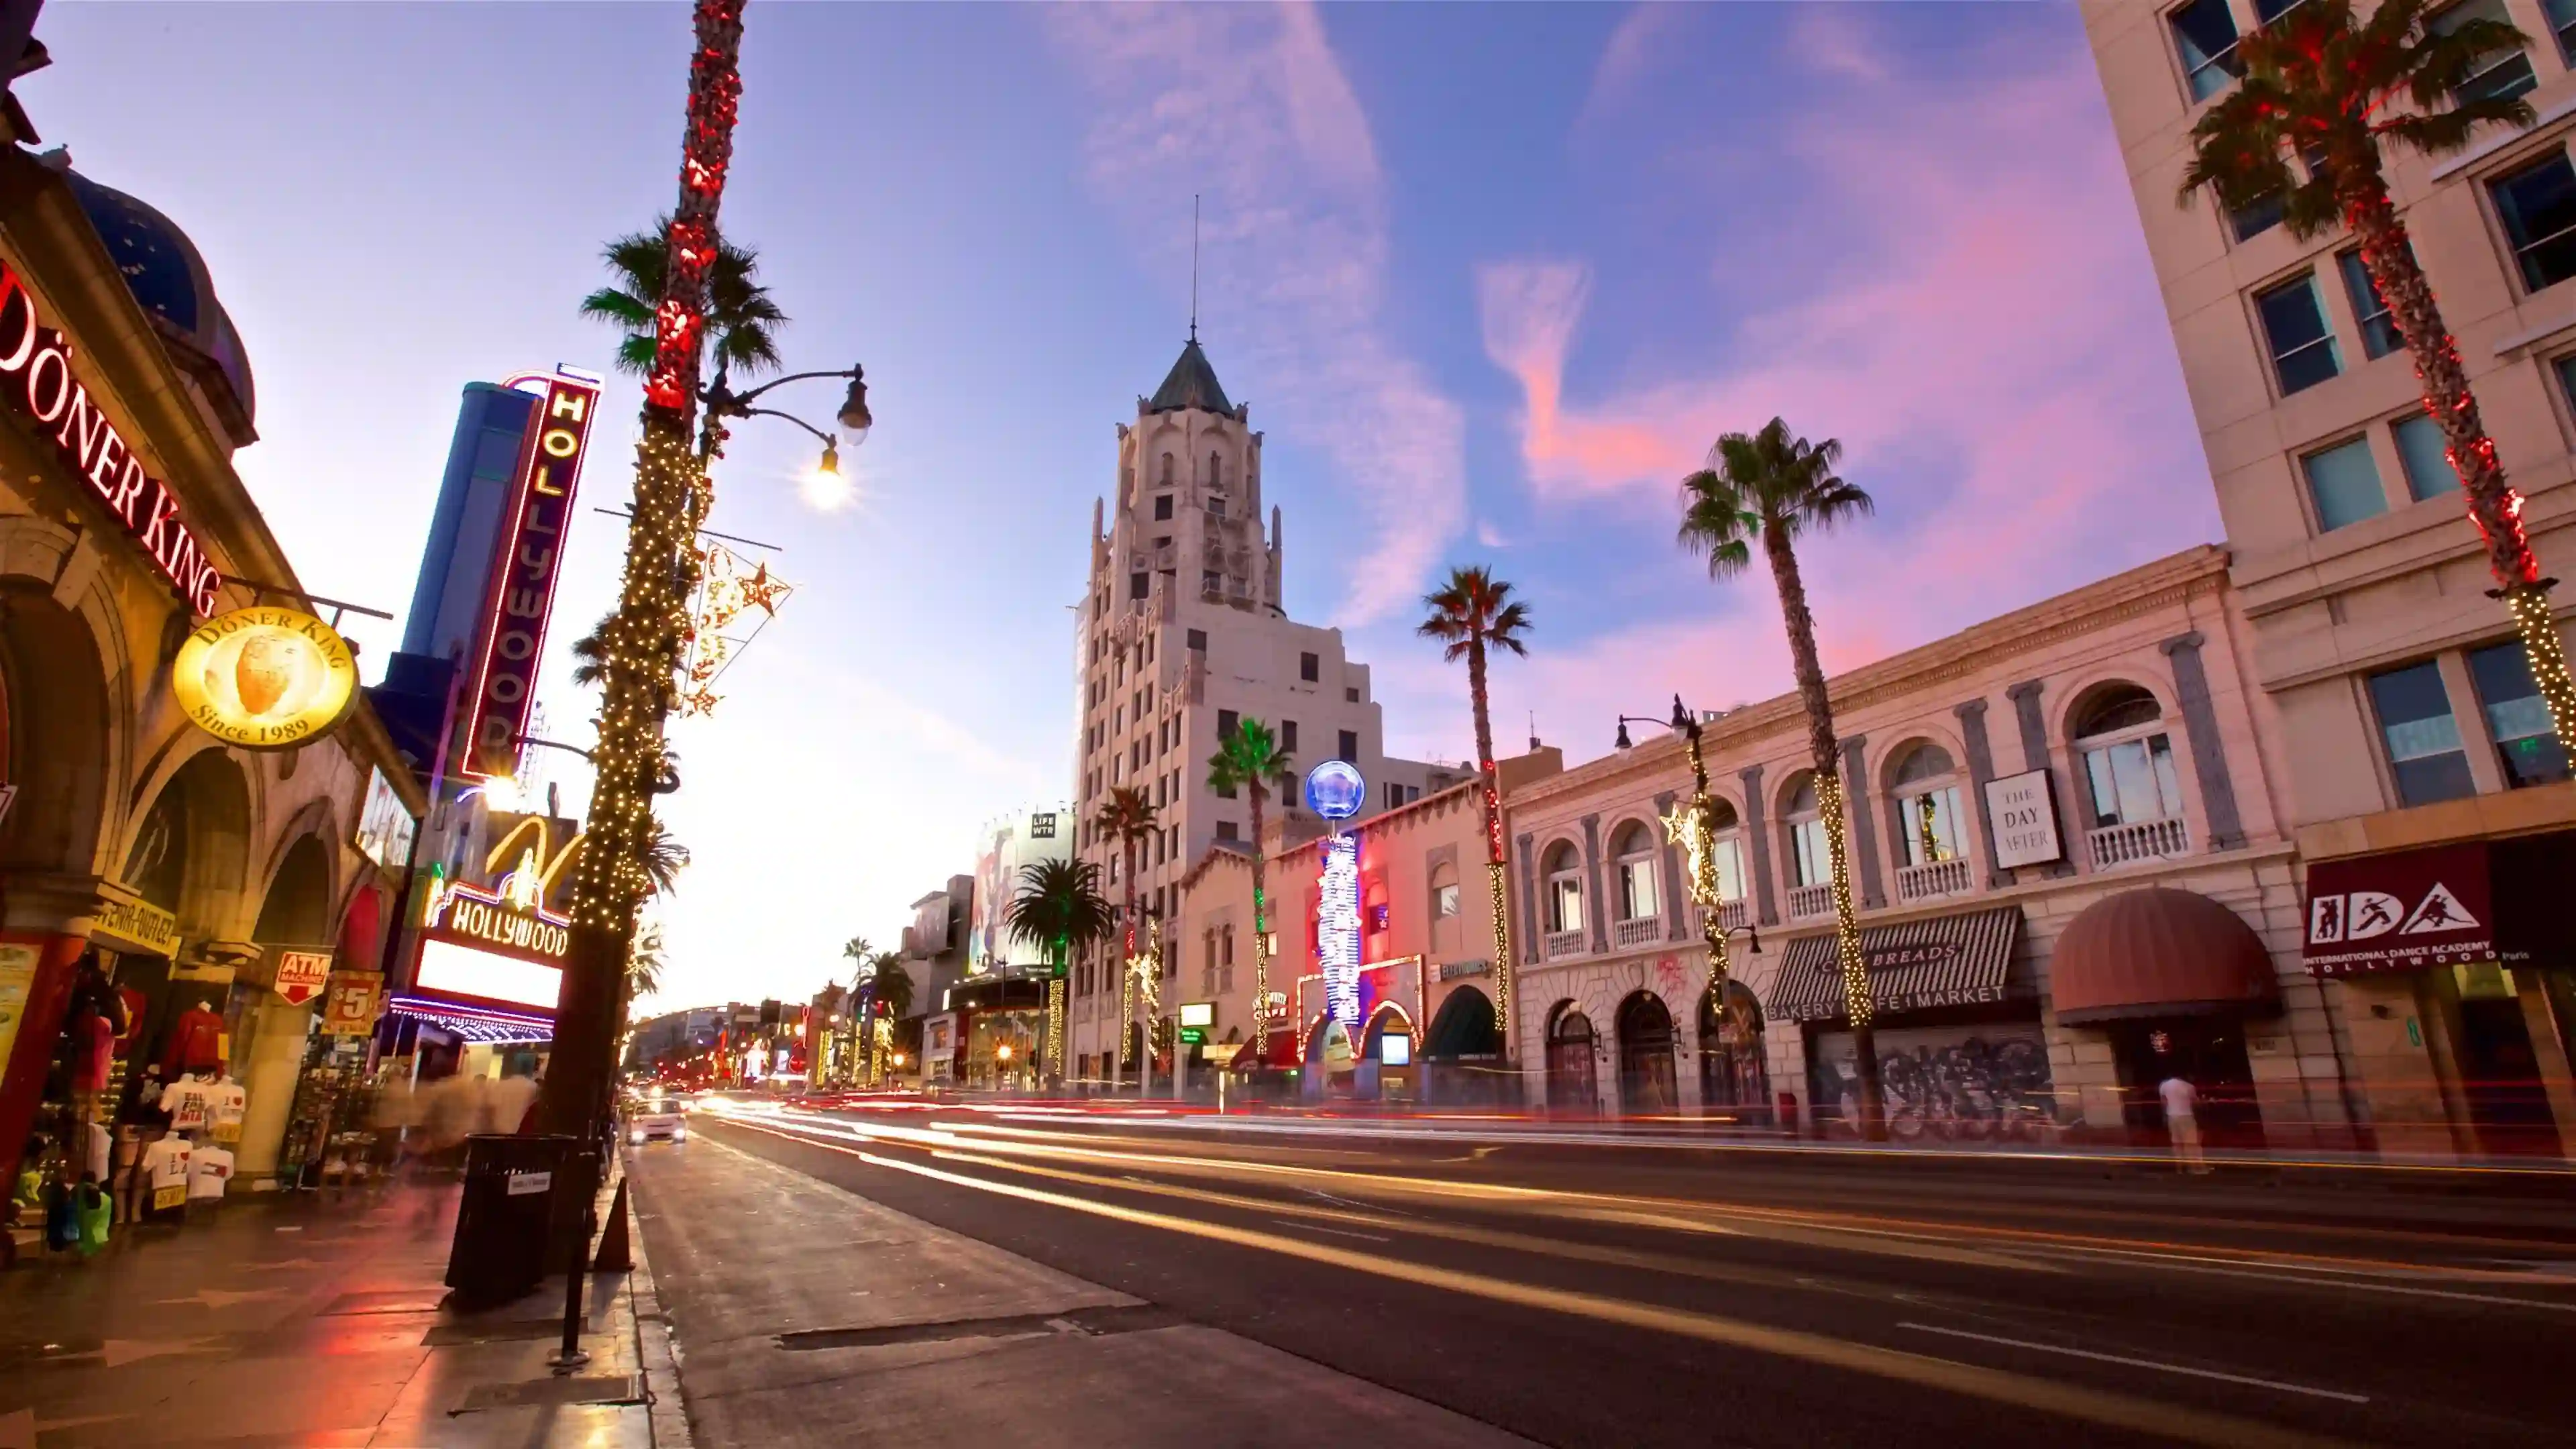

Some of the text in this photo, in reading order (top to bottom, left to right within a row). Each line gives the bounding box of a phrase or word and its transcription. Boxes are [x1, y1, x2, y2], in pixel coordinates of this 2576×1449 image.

[0, 259, 221, 619] DÖNER KING
[479, 391, 586, 747] HOLLYWOOD
[195, 612, 347, 669] DÖNER KING
[192, 704, 309, 741] Since 1989
[2002, 788, 2034, 804] THE
[1034, 817, 1054, 825] LIFE
[2004, 806, 2038, 828] DAY
[1033, 826, 1053, 835] WTR
[2006, 830, 2048, 852] AFTER
[2310, 881, 2481, 945] IDA
[452, 899, 569, 957] HOLLYWOOD
[1872, 945, 1956, 967] BREADS
[2302, 941, 2491, 965] INTERNATIONAL DANCE ACADEMY
[2305, 951, 2496, 974] HOLLYWOOD
[282, 955, 329, 975] ATM
[280, 973, 324, 984] MACHINE
[1768, 1002, 1835, 1020] BAKERY
[1916, 985, 2003, 1008] MARKET
